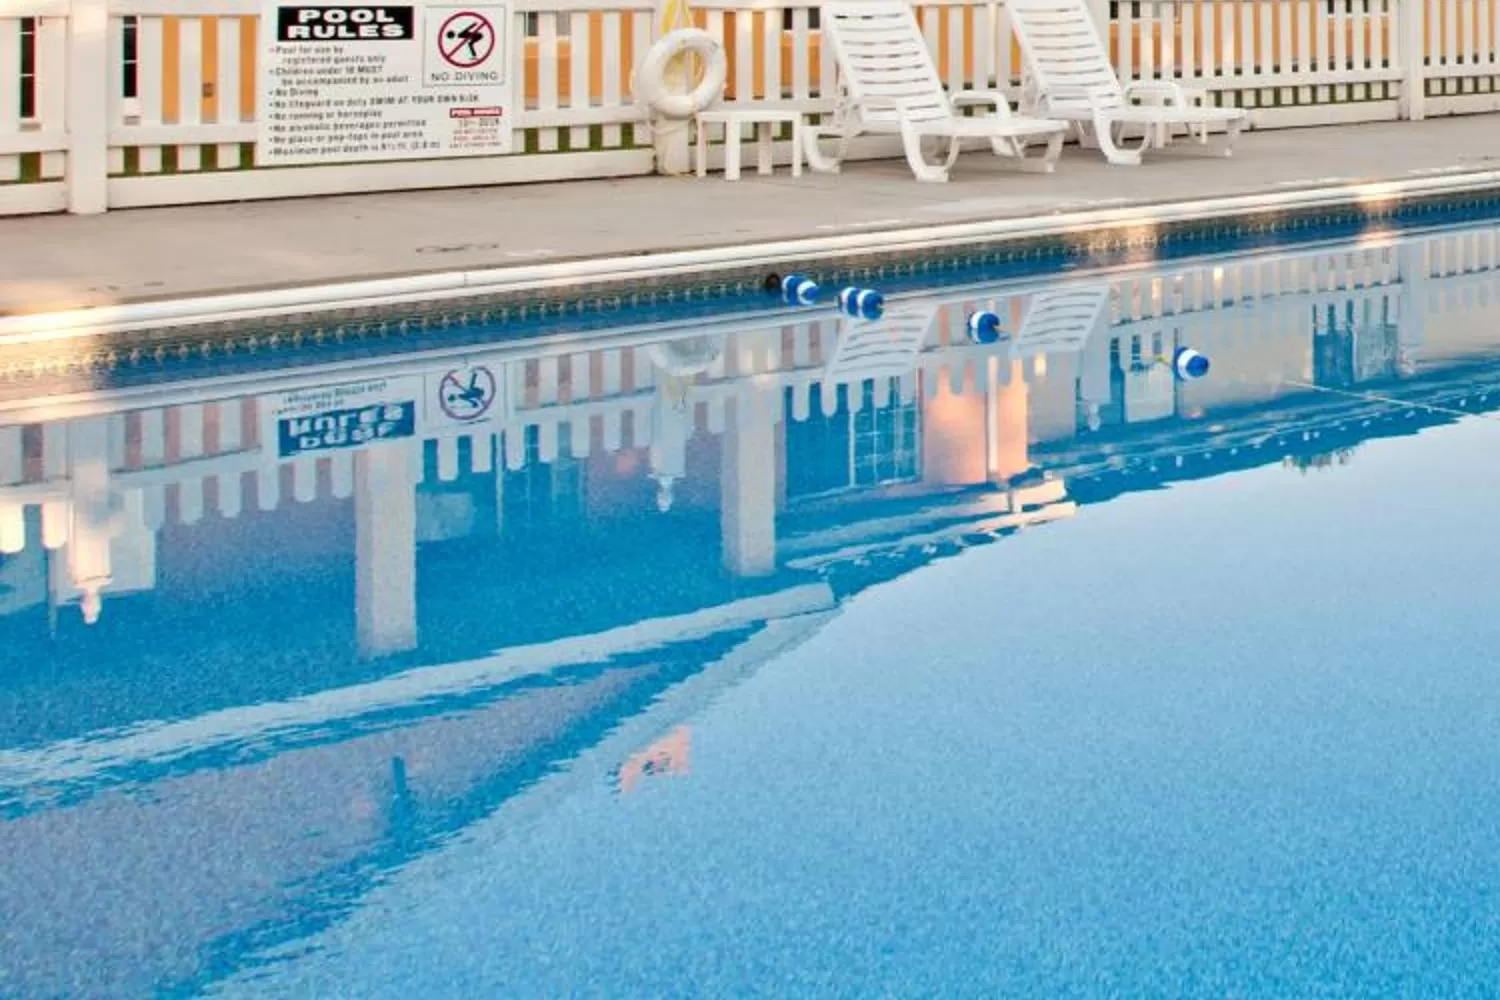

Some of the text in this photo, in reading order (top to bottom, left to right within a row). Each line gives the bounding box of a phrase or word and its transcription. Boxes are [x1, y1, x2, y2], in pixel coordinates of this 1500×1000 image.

[298, 9, 395, 23] POOL
[287, 25, 404, 38] RULES
[276, 66, 314, 75] Children
[316, 65, 341, 74] under
[358, 65, 383, 73] MUST
[431, 71, 498, 81] NO DIVING
[275, 87, 319, 98] No Diving
[289, 99, 331, 109] lifeguard
[411, 95, 435, 104] YOUR
[289, 111, 324, 121] running
[383, 119, 427, 129] permitted
[273, 147, 318, 156] Maximum
